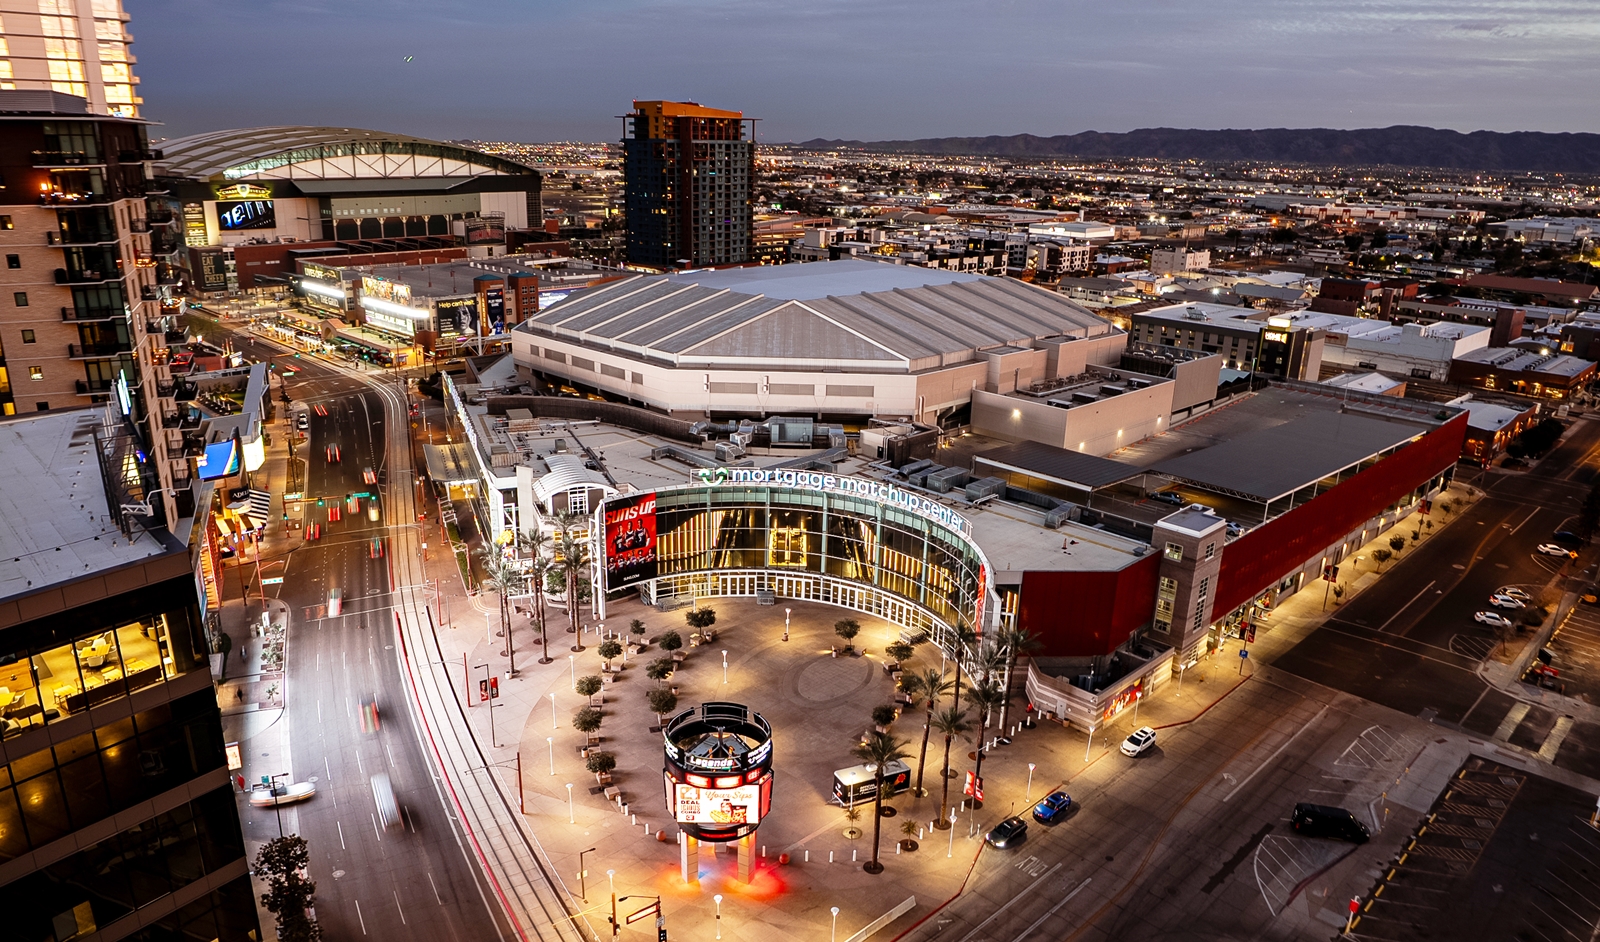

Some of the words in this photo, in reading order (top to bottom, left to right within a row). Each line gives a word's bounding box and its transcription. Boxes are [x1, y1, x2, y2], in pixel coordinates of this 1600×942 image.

[202, 256, 214, 265] EAT
[203, 265, 215, 274] BET
[205, 273, 225, 284] CHEER
[732, 468, 836, 491] mortgage
[840, 477, 920, 510] matchup
[922, 499, 965, 530] center
[605, 505, 639, 526] SUNS
[638, 500, 656, 516] UP
[704, 790, 731, 801] Your
[731, 790, 753, 801] Sips
